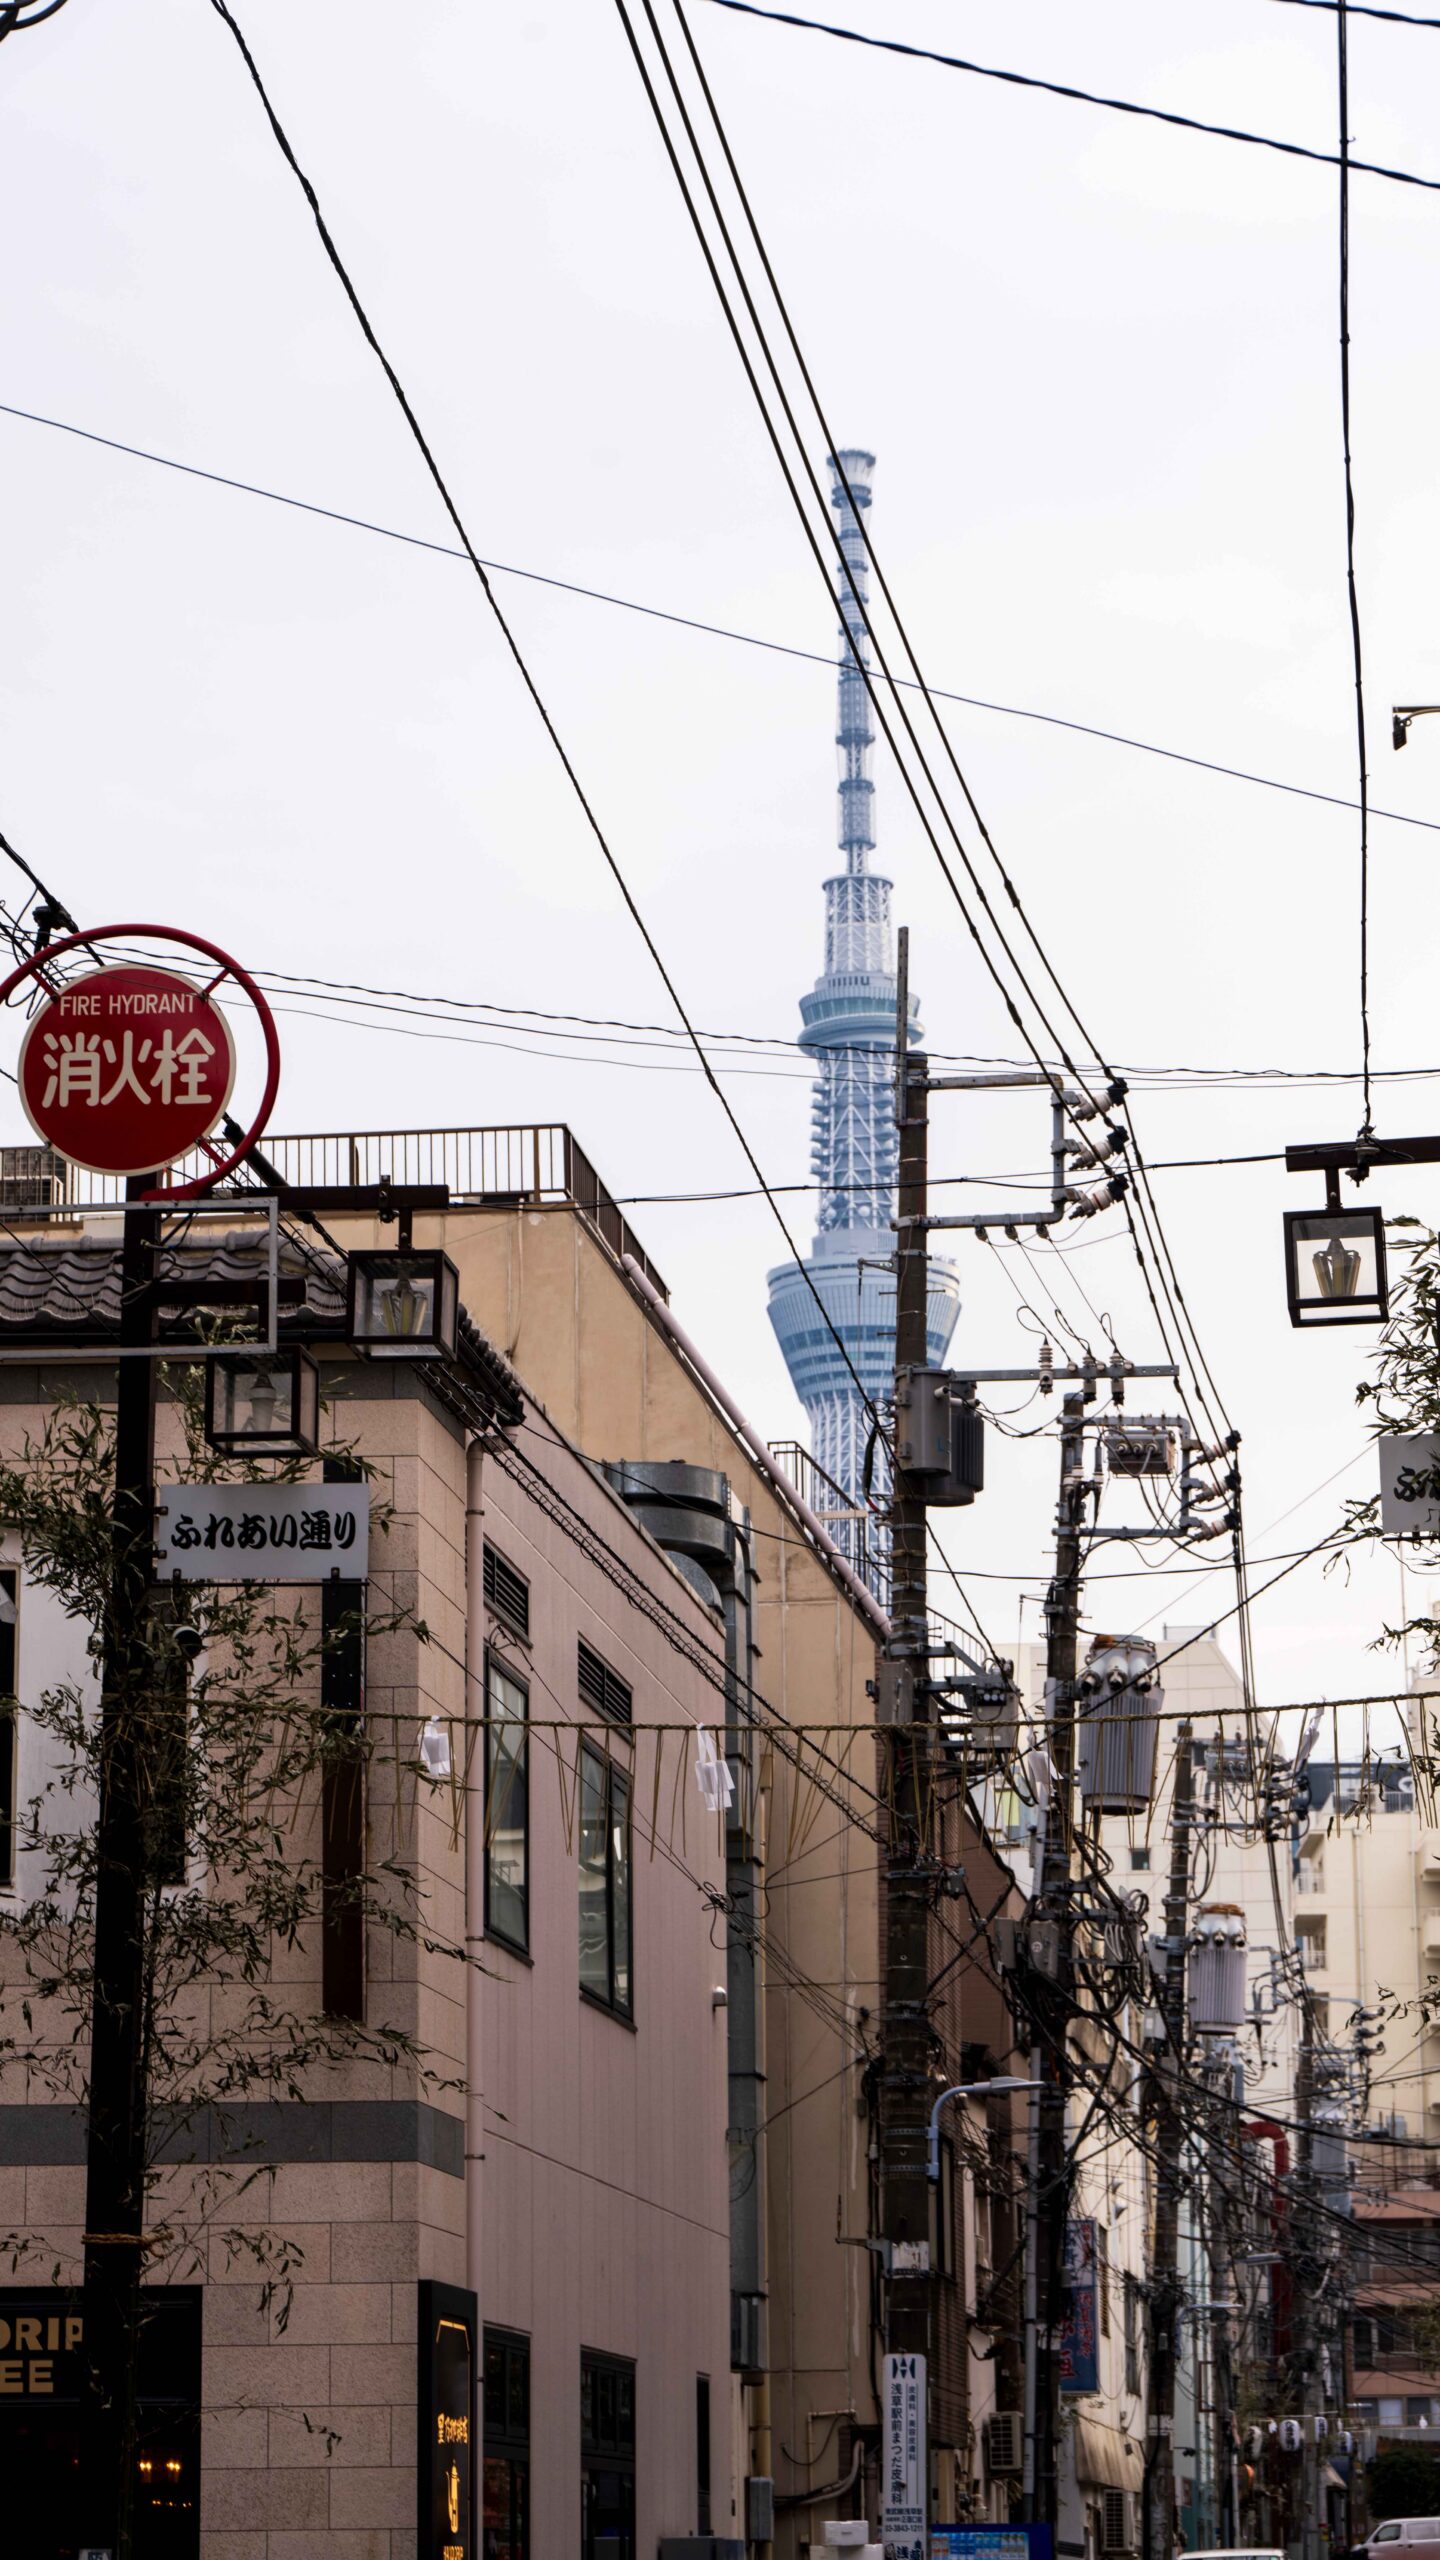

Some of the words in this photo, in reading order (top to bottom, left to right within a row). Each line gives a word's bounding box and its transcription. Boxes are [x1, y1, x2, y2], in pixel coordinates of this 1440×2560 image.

[59, 996, 101, 1017] FIRE
[108, 993, 197, 1015] HYDRANT
[41, 1027, 216, 1109] 消火栓
[171, 1510, 357, 1551] ふれあい通り
